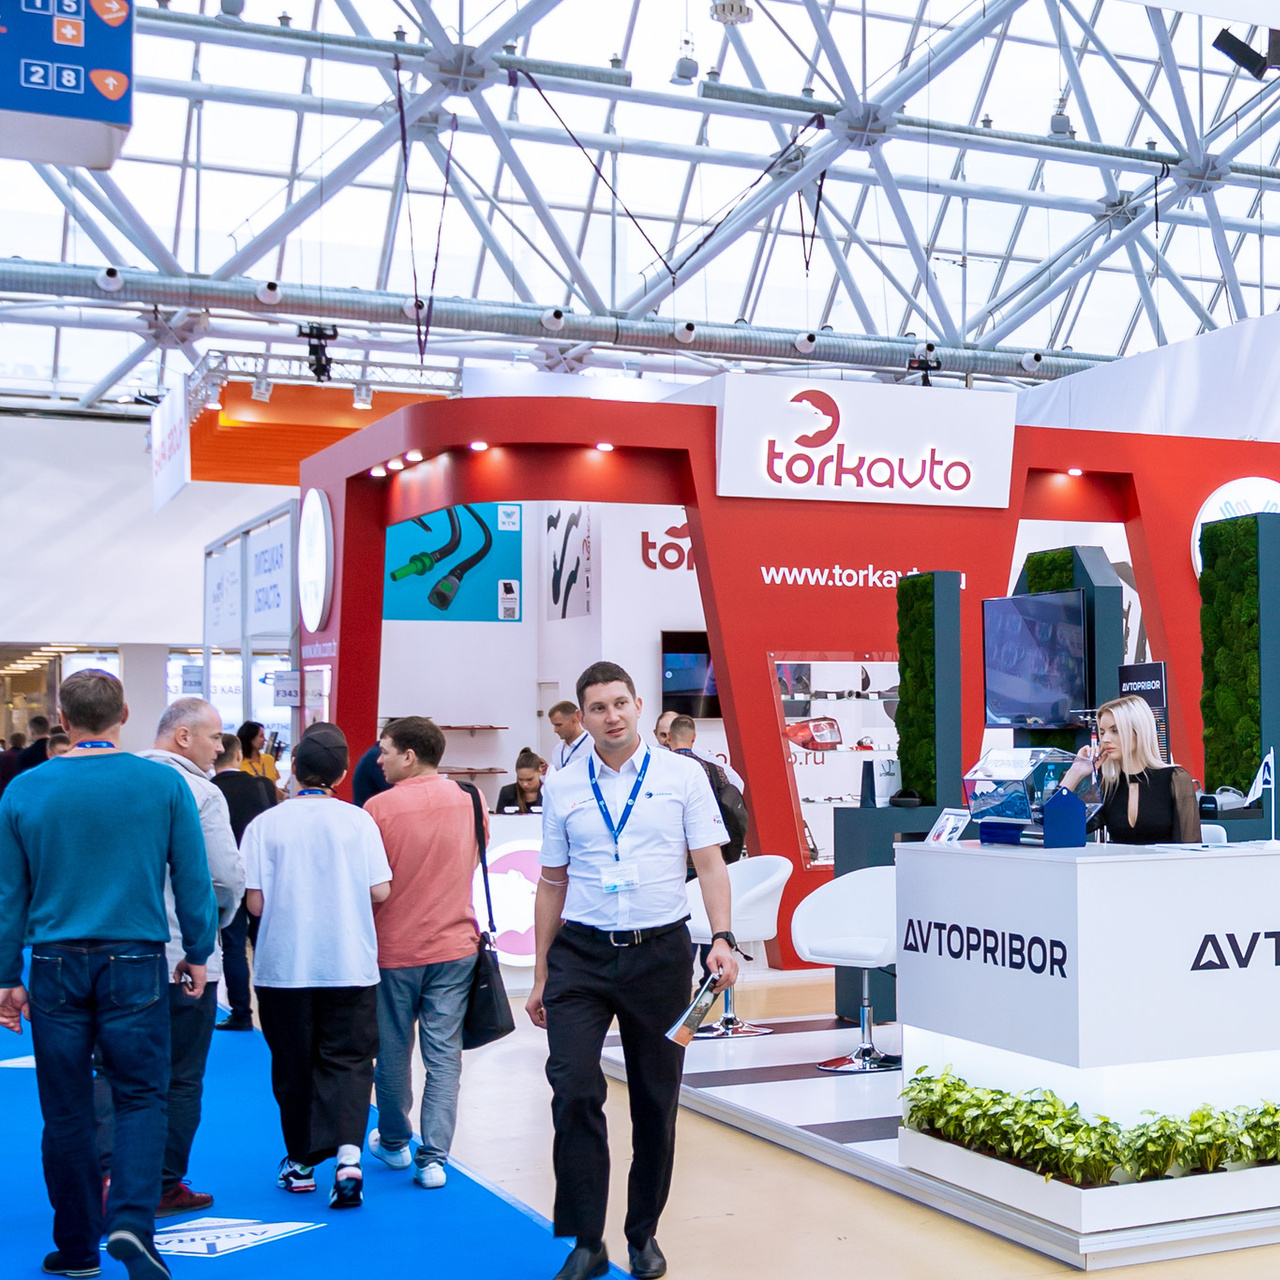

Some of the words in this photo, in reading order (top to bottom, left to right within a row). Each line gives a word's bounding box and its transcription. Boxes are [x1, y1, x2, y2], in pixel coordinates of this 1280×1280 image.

[30, 66, 45, 84] 2
[61, 70, 77, 87] 8
[766, 439, 972, 491] torkavto
[276, 689, 299, 698] F343
[1121, 680, 1161, 692] AVTOPRIBOR
[903, 917, 1068, 979] AVTOPRIBOR
